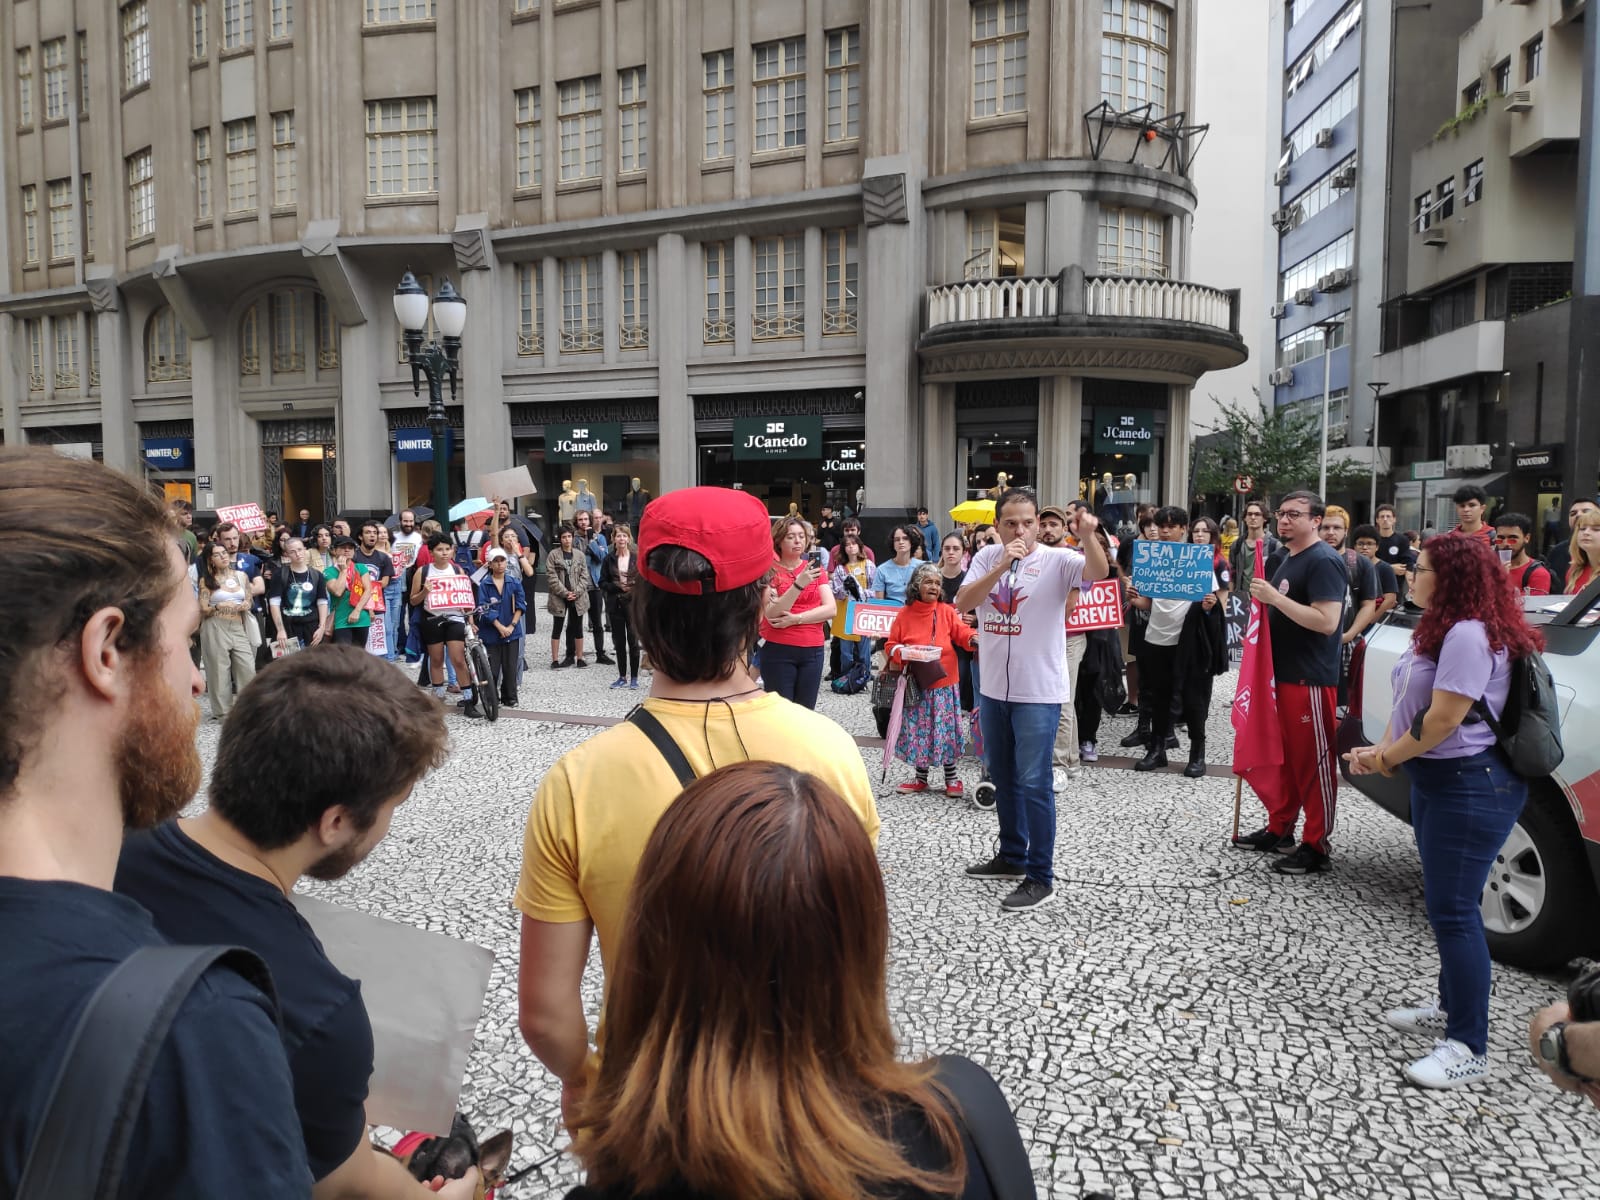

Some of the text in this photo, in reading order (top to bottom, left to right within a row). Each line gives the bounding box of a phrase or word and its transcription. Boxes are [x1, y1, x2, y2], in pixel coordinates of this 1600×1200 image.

[1103, 427, 1151, 440] JCanedo
[398, 440, 432, 449] UNINTER
[553, 440, 608, 452] JCanedo
[744, 434, 807, 448] JCanedo
[146, 448, 172, 457] UNINTER
[221, 506, 260, 522] ESTAMOS
[240, 517, 266, 530] GREVE
[1135, 543, 1173, 563] SEM
[1151, 556, 1197, 568] NÃO TEM
[1132, 567, 1184, 578] FORMAÇÃO
[1135, 580, 1203, 594] PROFESSORES
[431, 593, 449, 606] EM
[1075, 586, 1116, 607] MOS
[1068, 606, 1118, 626] GREVE
[859, 614, 896, 632] GREV
[375, 617, 385, 649] GREVE
